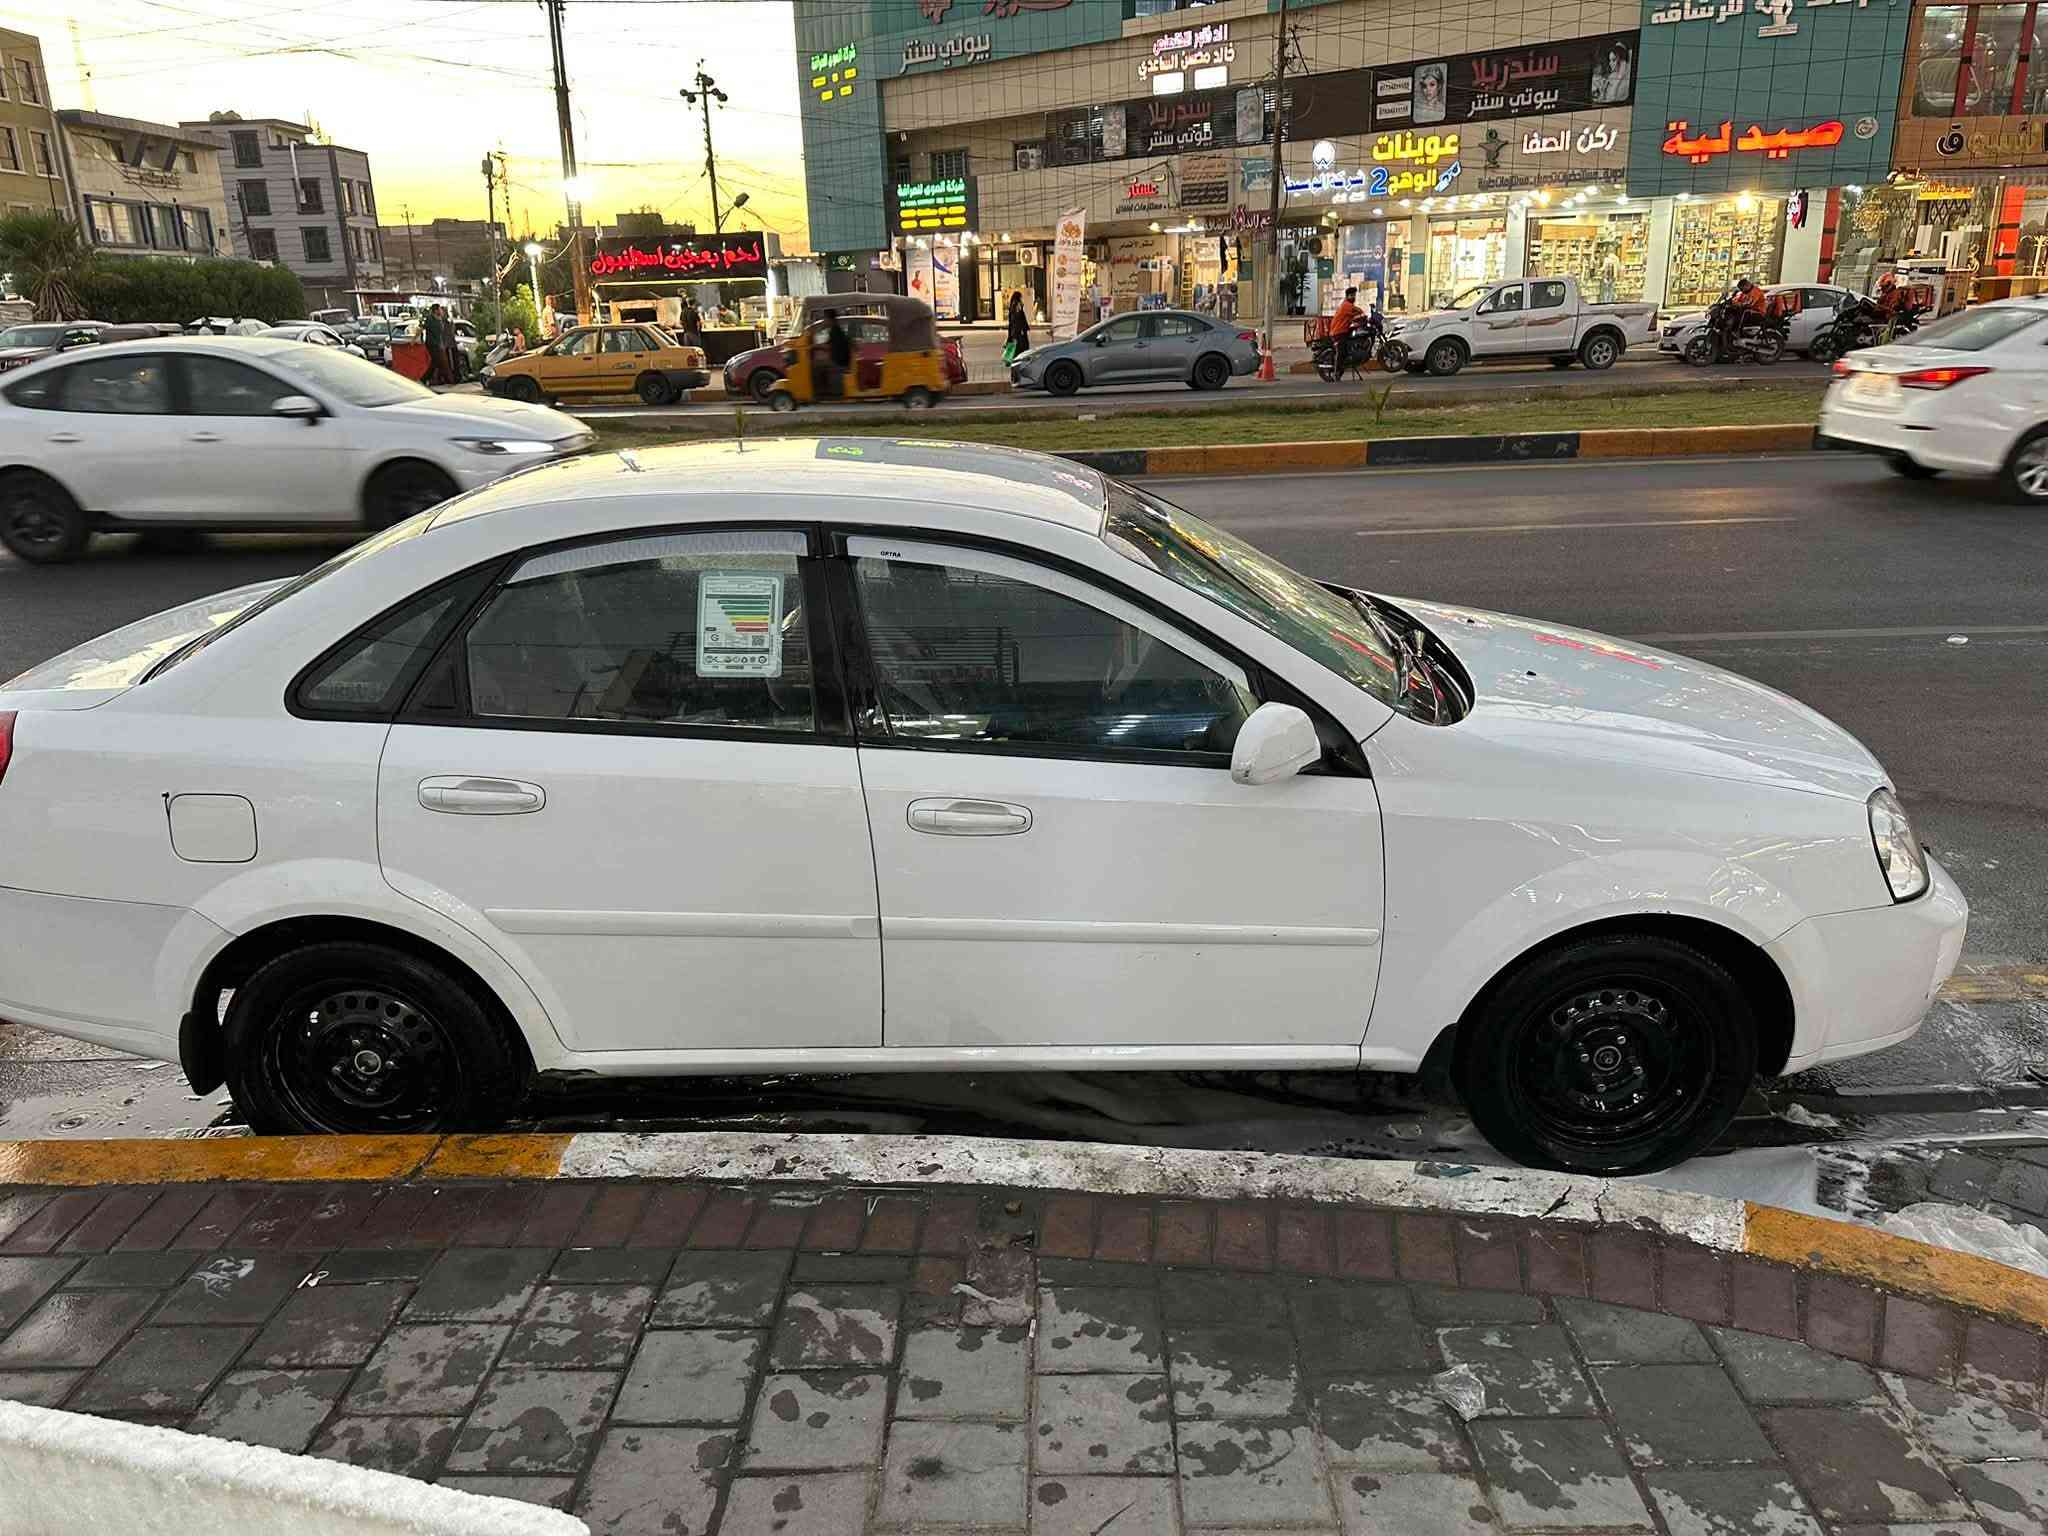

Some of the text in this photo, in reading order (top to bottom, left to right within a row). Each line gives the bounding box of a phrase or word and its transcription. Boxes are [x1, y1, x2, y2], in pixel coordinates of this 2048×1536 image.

[899, 32, 991, 74] بيوتي سنتر
[1138, 43, 1235, 81] خالد محسن الساعدي
[1471, 51, 1560, 93] سندريلا
[1467, 87, 1559, 118] بيوتي سنتر
[1147, 124, 1213, 151] بيوتي سنتر
[1372, 131, 1460, 166] عوينات
[1521, 124, 1618, 154] ركن الصفا
[1662, 120, 1844, 164] صيدلية
[1329, 169, 1366, 192] شركة
[1370, 167, 1437, 196] الوهج 2
[723, 241, 762, 269] لحم
